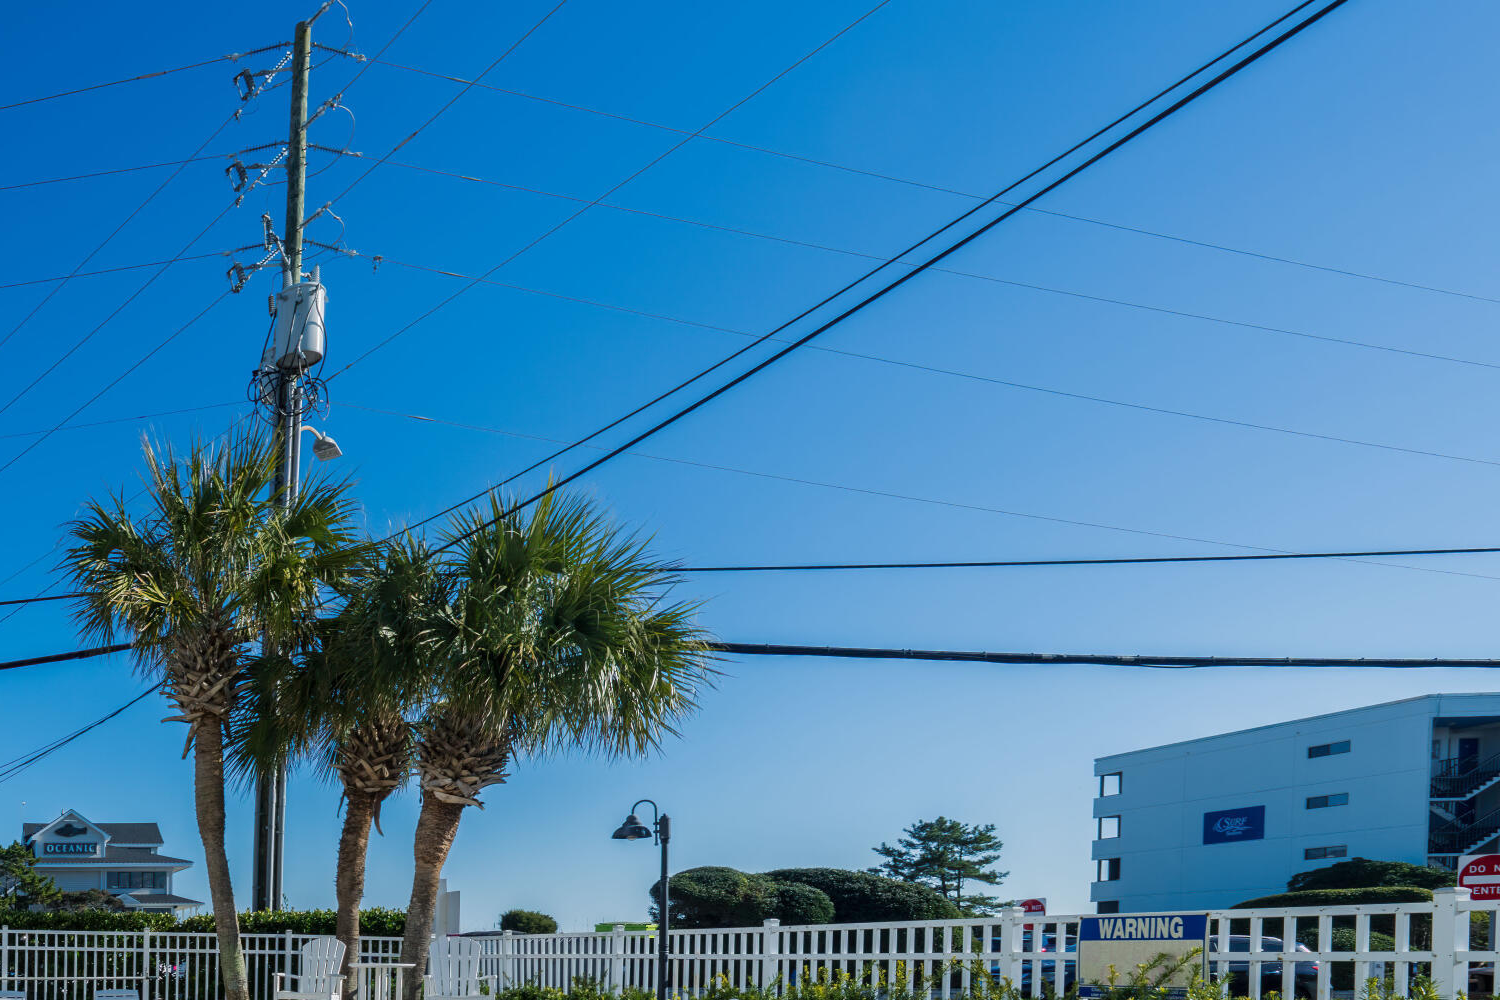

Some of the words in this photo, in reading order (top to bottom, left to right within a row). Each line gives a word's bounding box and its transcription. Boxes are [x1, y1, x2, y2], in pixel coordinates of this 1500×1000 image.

[46, 844, 95, 853] OCEANIC
[1469, 865, 1486, 873] DO
[1098, 917, 1184, 939] WARNING
